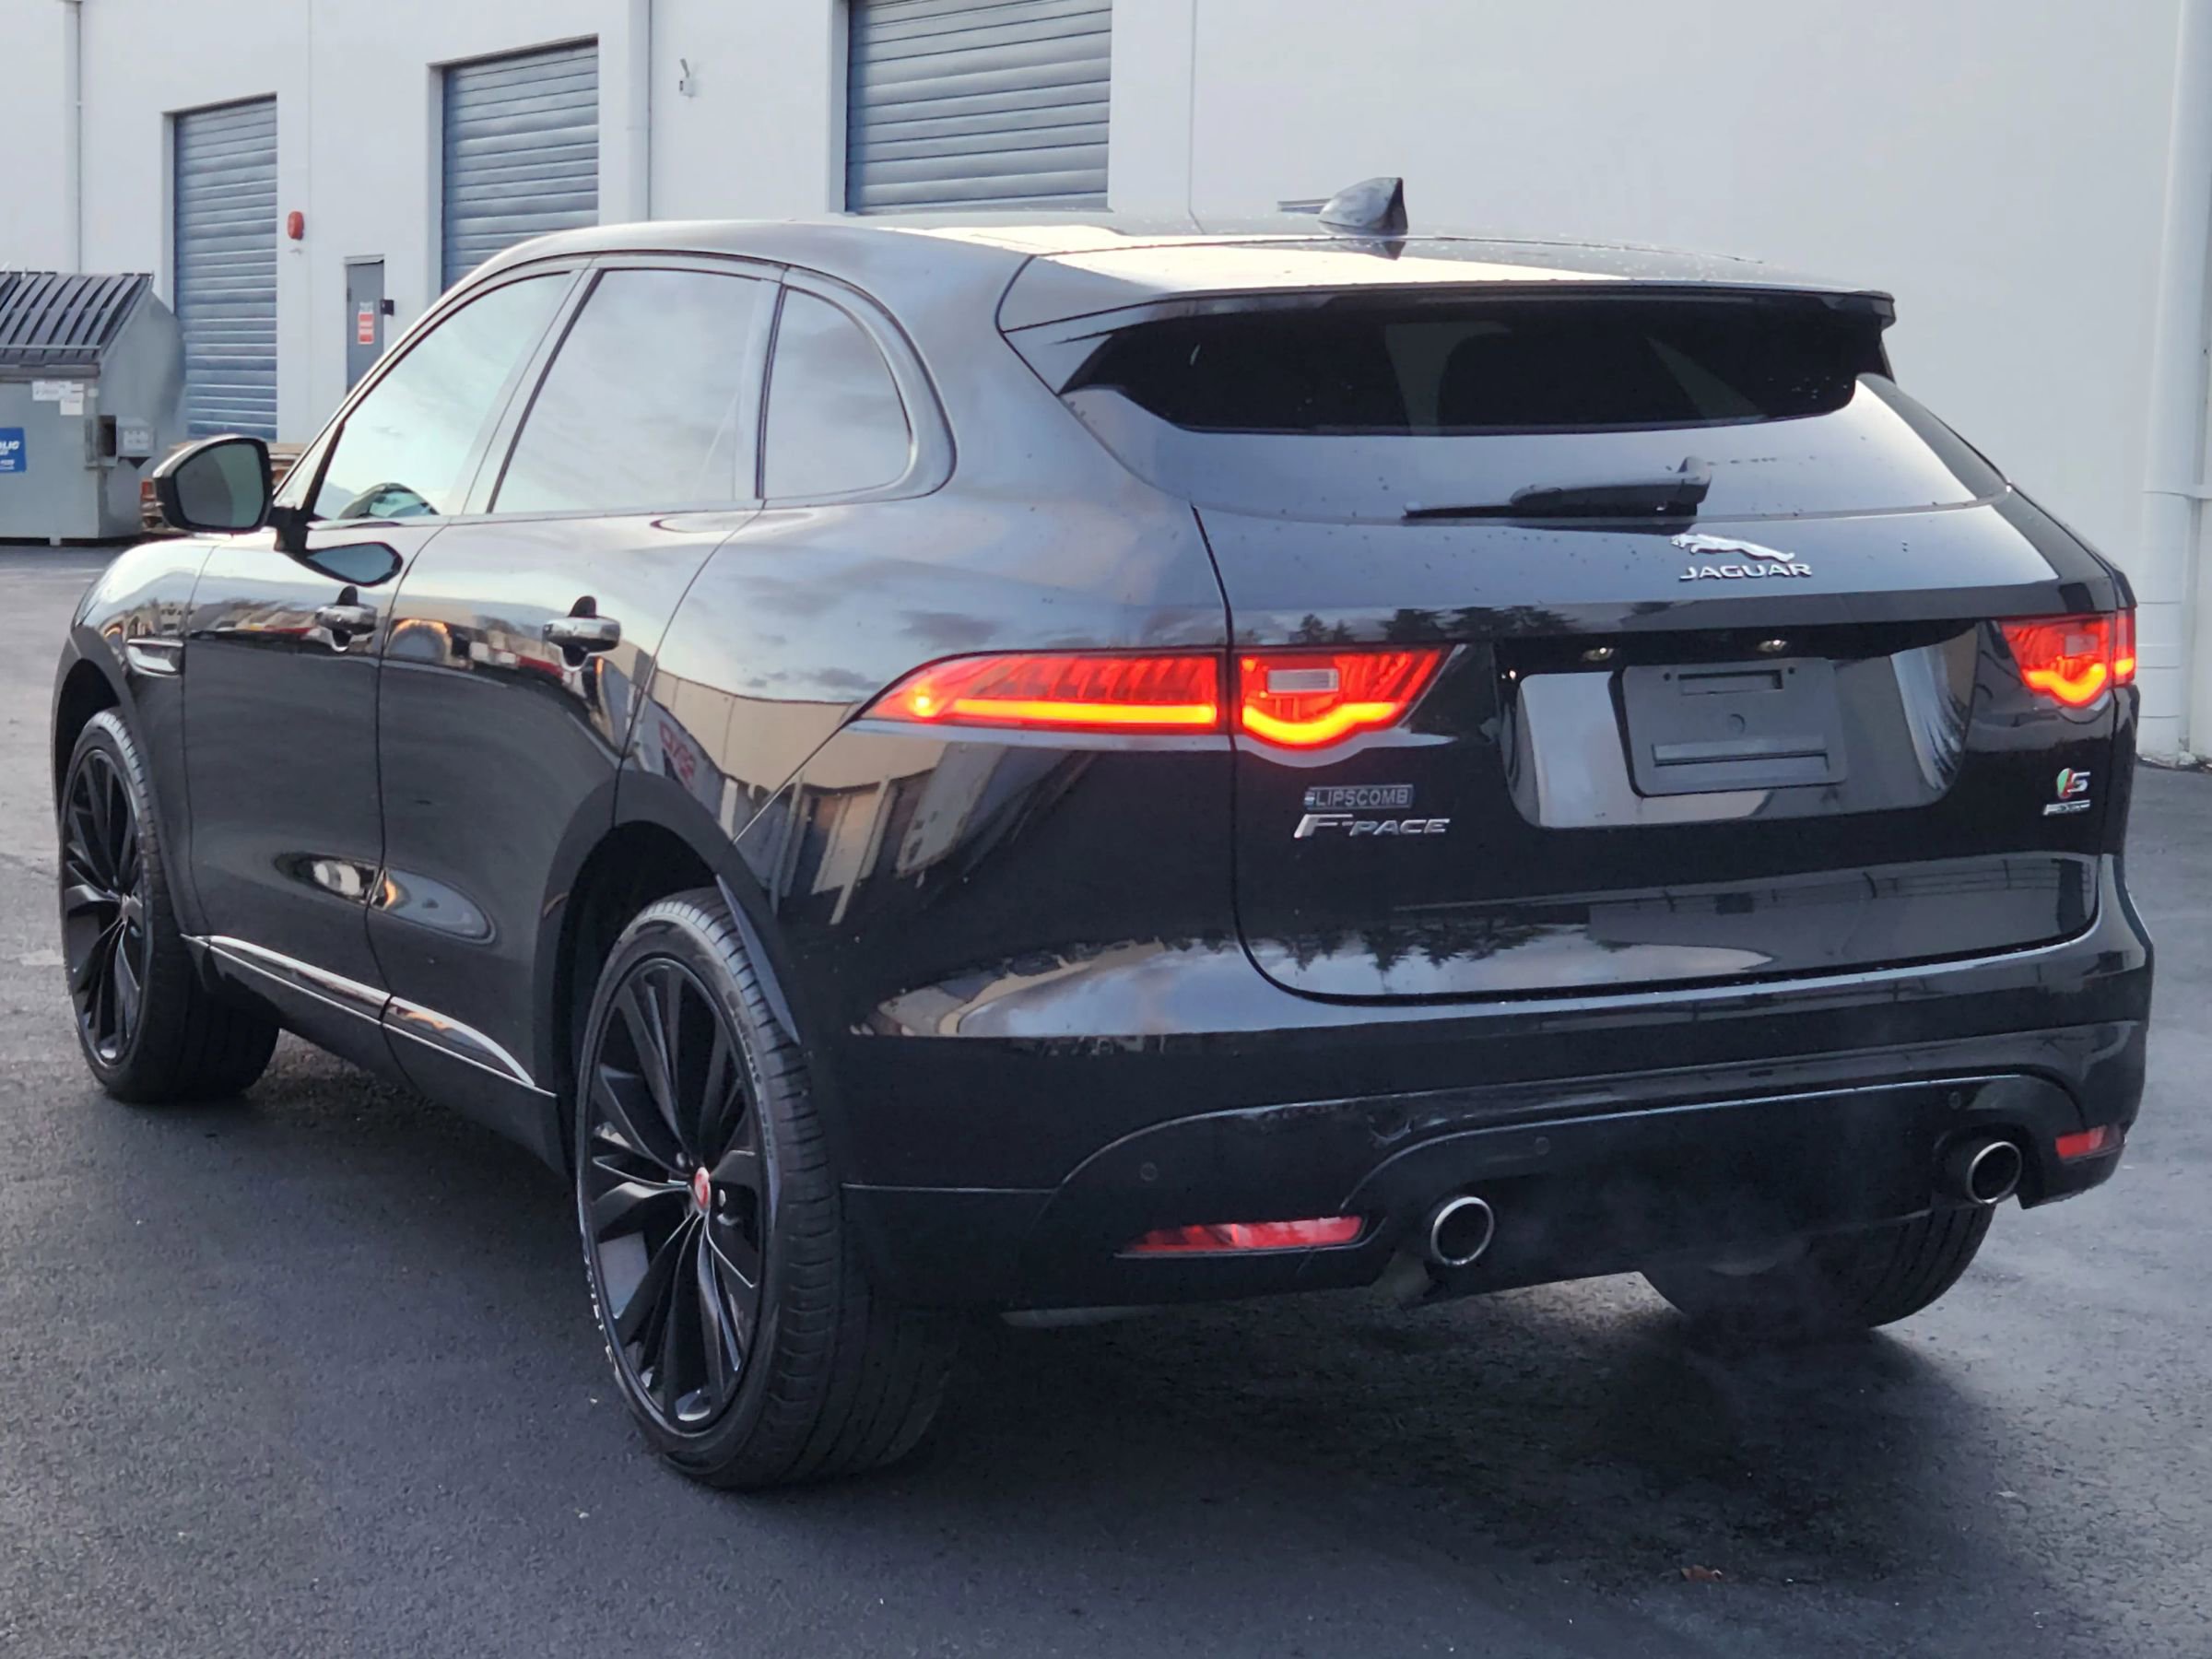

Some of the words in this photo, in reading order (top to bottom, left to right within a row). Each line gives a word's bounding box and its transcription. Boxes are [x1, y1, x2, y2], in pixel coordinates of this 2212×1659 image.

[1678, 563, 1813, 581] JAGUAR
[1315, 788, 1409, 807] LIPSCOMB
[1293, 814, 1450, 838] F-PACE
